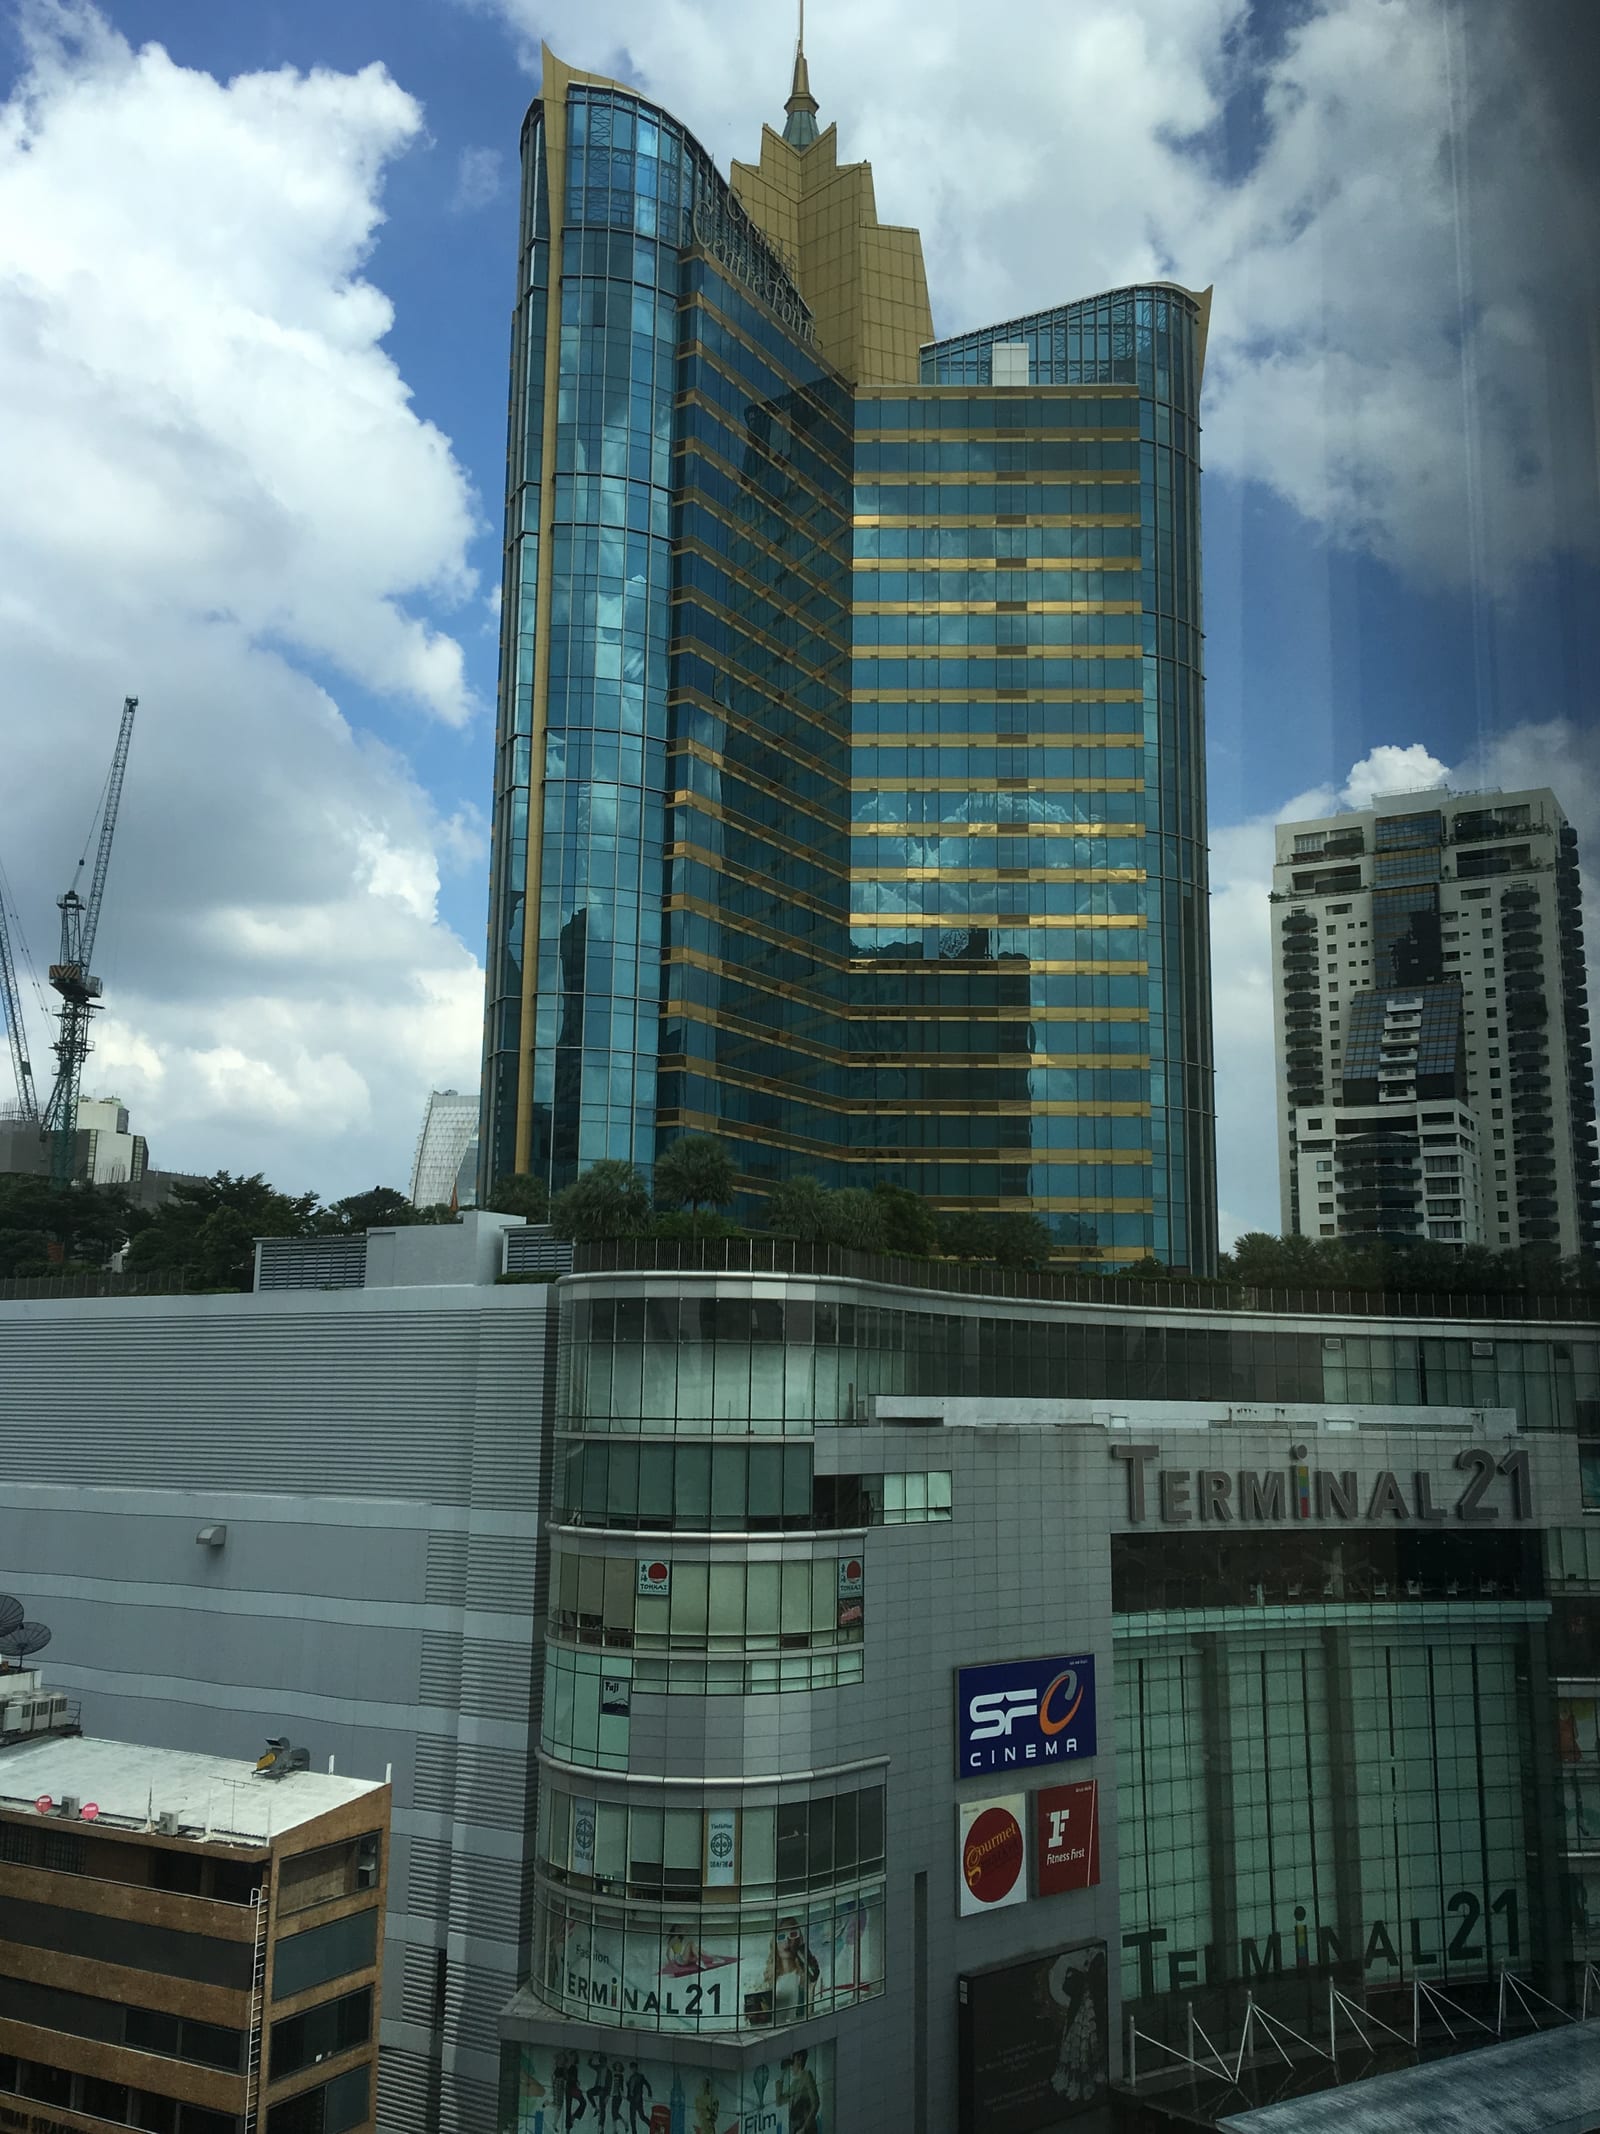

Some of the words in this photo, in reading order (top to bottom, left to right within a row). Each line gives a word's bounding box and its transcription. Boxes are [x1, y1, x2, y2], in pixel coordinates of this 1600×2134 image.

[693, 200, 762, 297] Centre
[766, 277, 823, 350] Point
[1457, 1448, 1532, 1521] 21
[969, 1738, 1078, 1768] CINEMA
[1046, 1852, 1070, 1866] Fitness
[1070, 1848, 1085, 1860] First
[1447, 1889, 1519, 1961] 21
[685, 1983, 721, 2015] 21
[745, 2112, 777, 2134] Film
